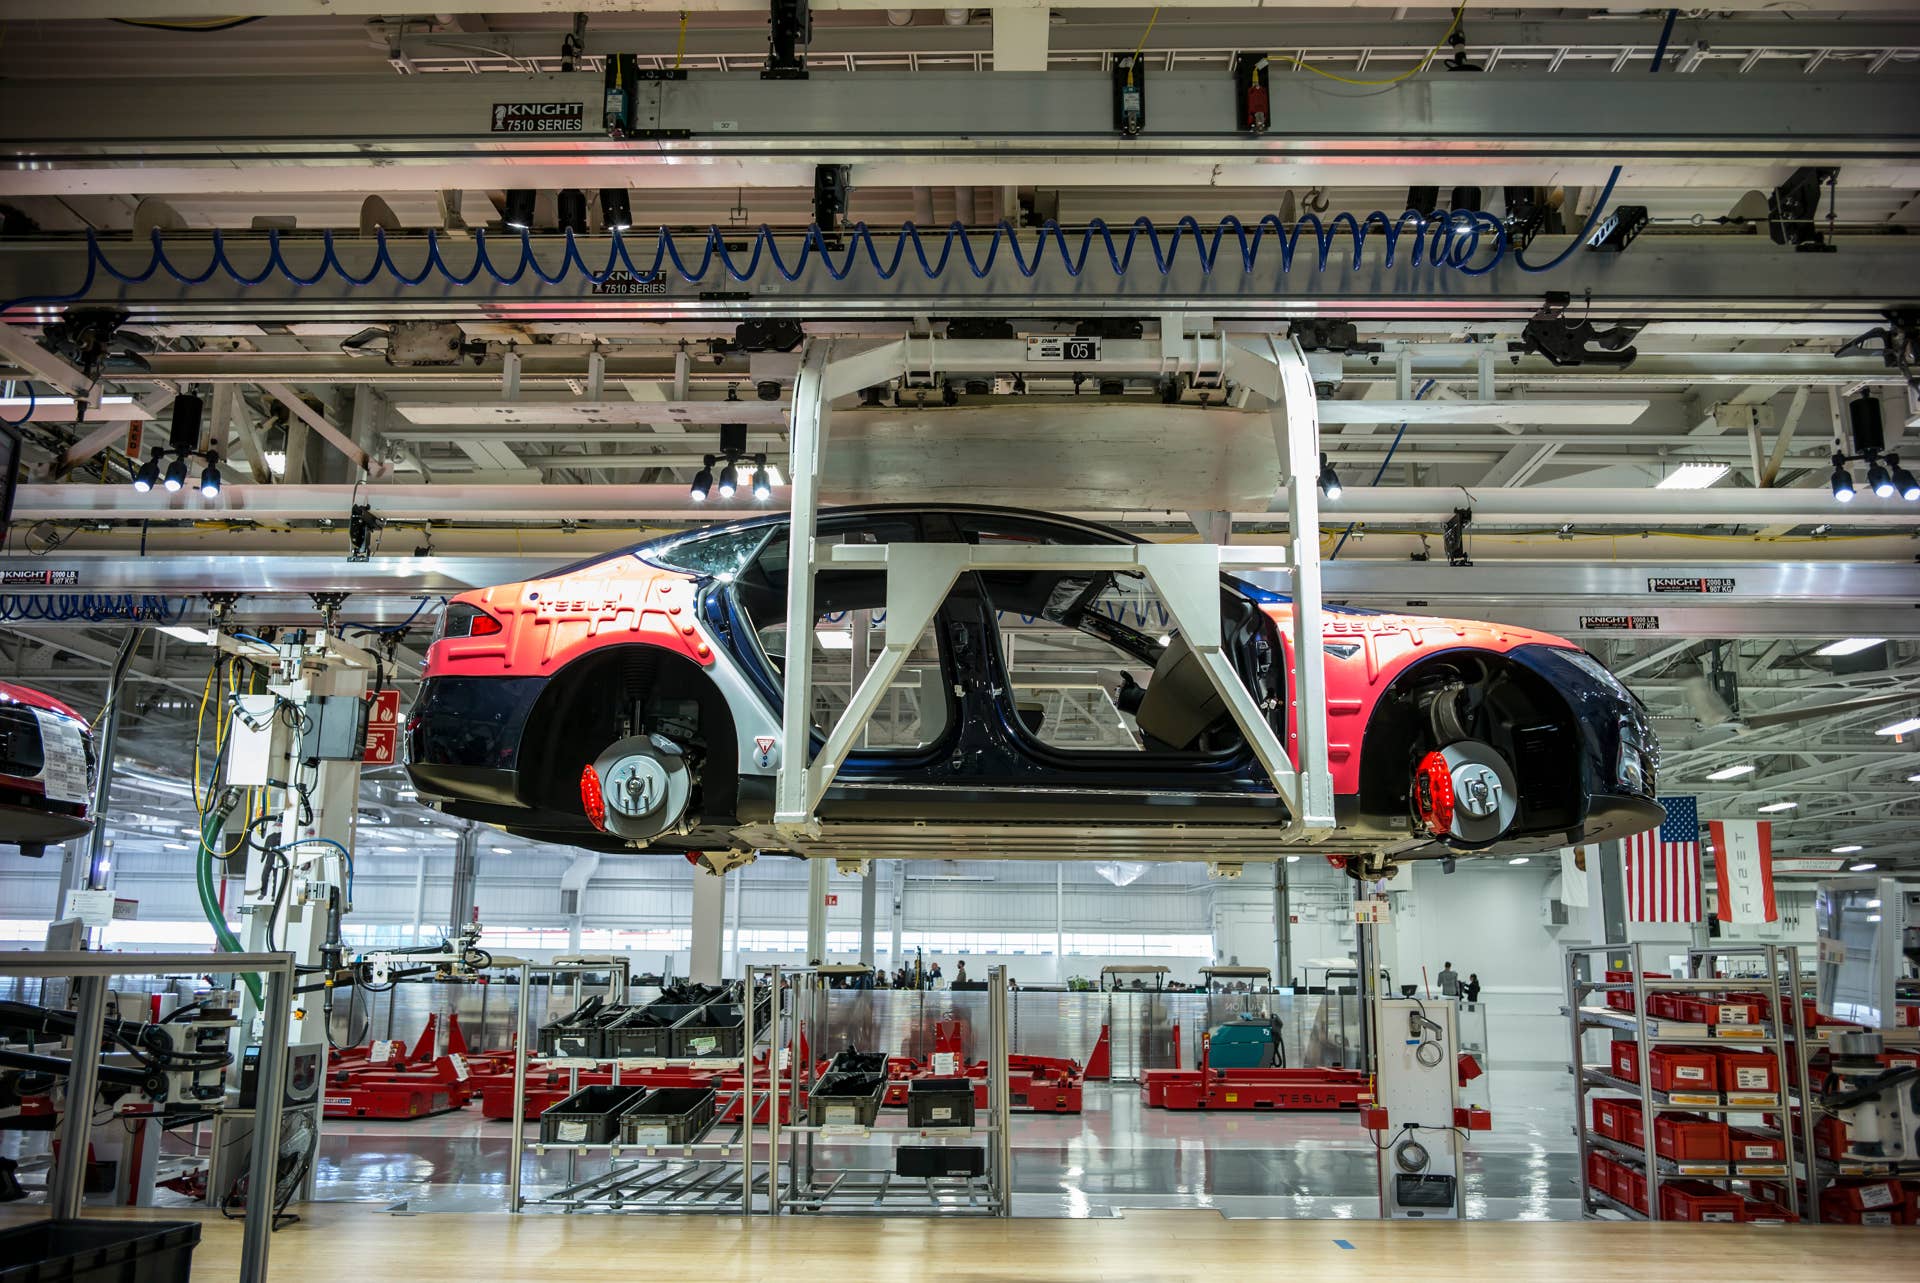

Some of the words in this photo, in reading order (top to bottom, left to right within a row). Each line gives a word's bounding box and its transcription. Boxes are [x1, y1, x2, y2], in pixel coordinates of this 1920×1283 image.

[507, 104, 583, 115] KNIGHT
[507, 120, 534, 131] 7510
[537, 119, 581, 131] SERIES
[606, 271, 667, 281] KNIT
[605, 285, 627, 294] 7510
[629, 284, 666, 293] SERIES
[1070, 343, 1088, 359] 05
[1656, 578, 1699, 586] KNIGHT
[538, 600, 617, 612] TESLA
[1735, 831, 1752, 913] TESLA
[1277, 1094, 1337, 1104] TESLA
